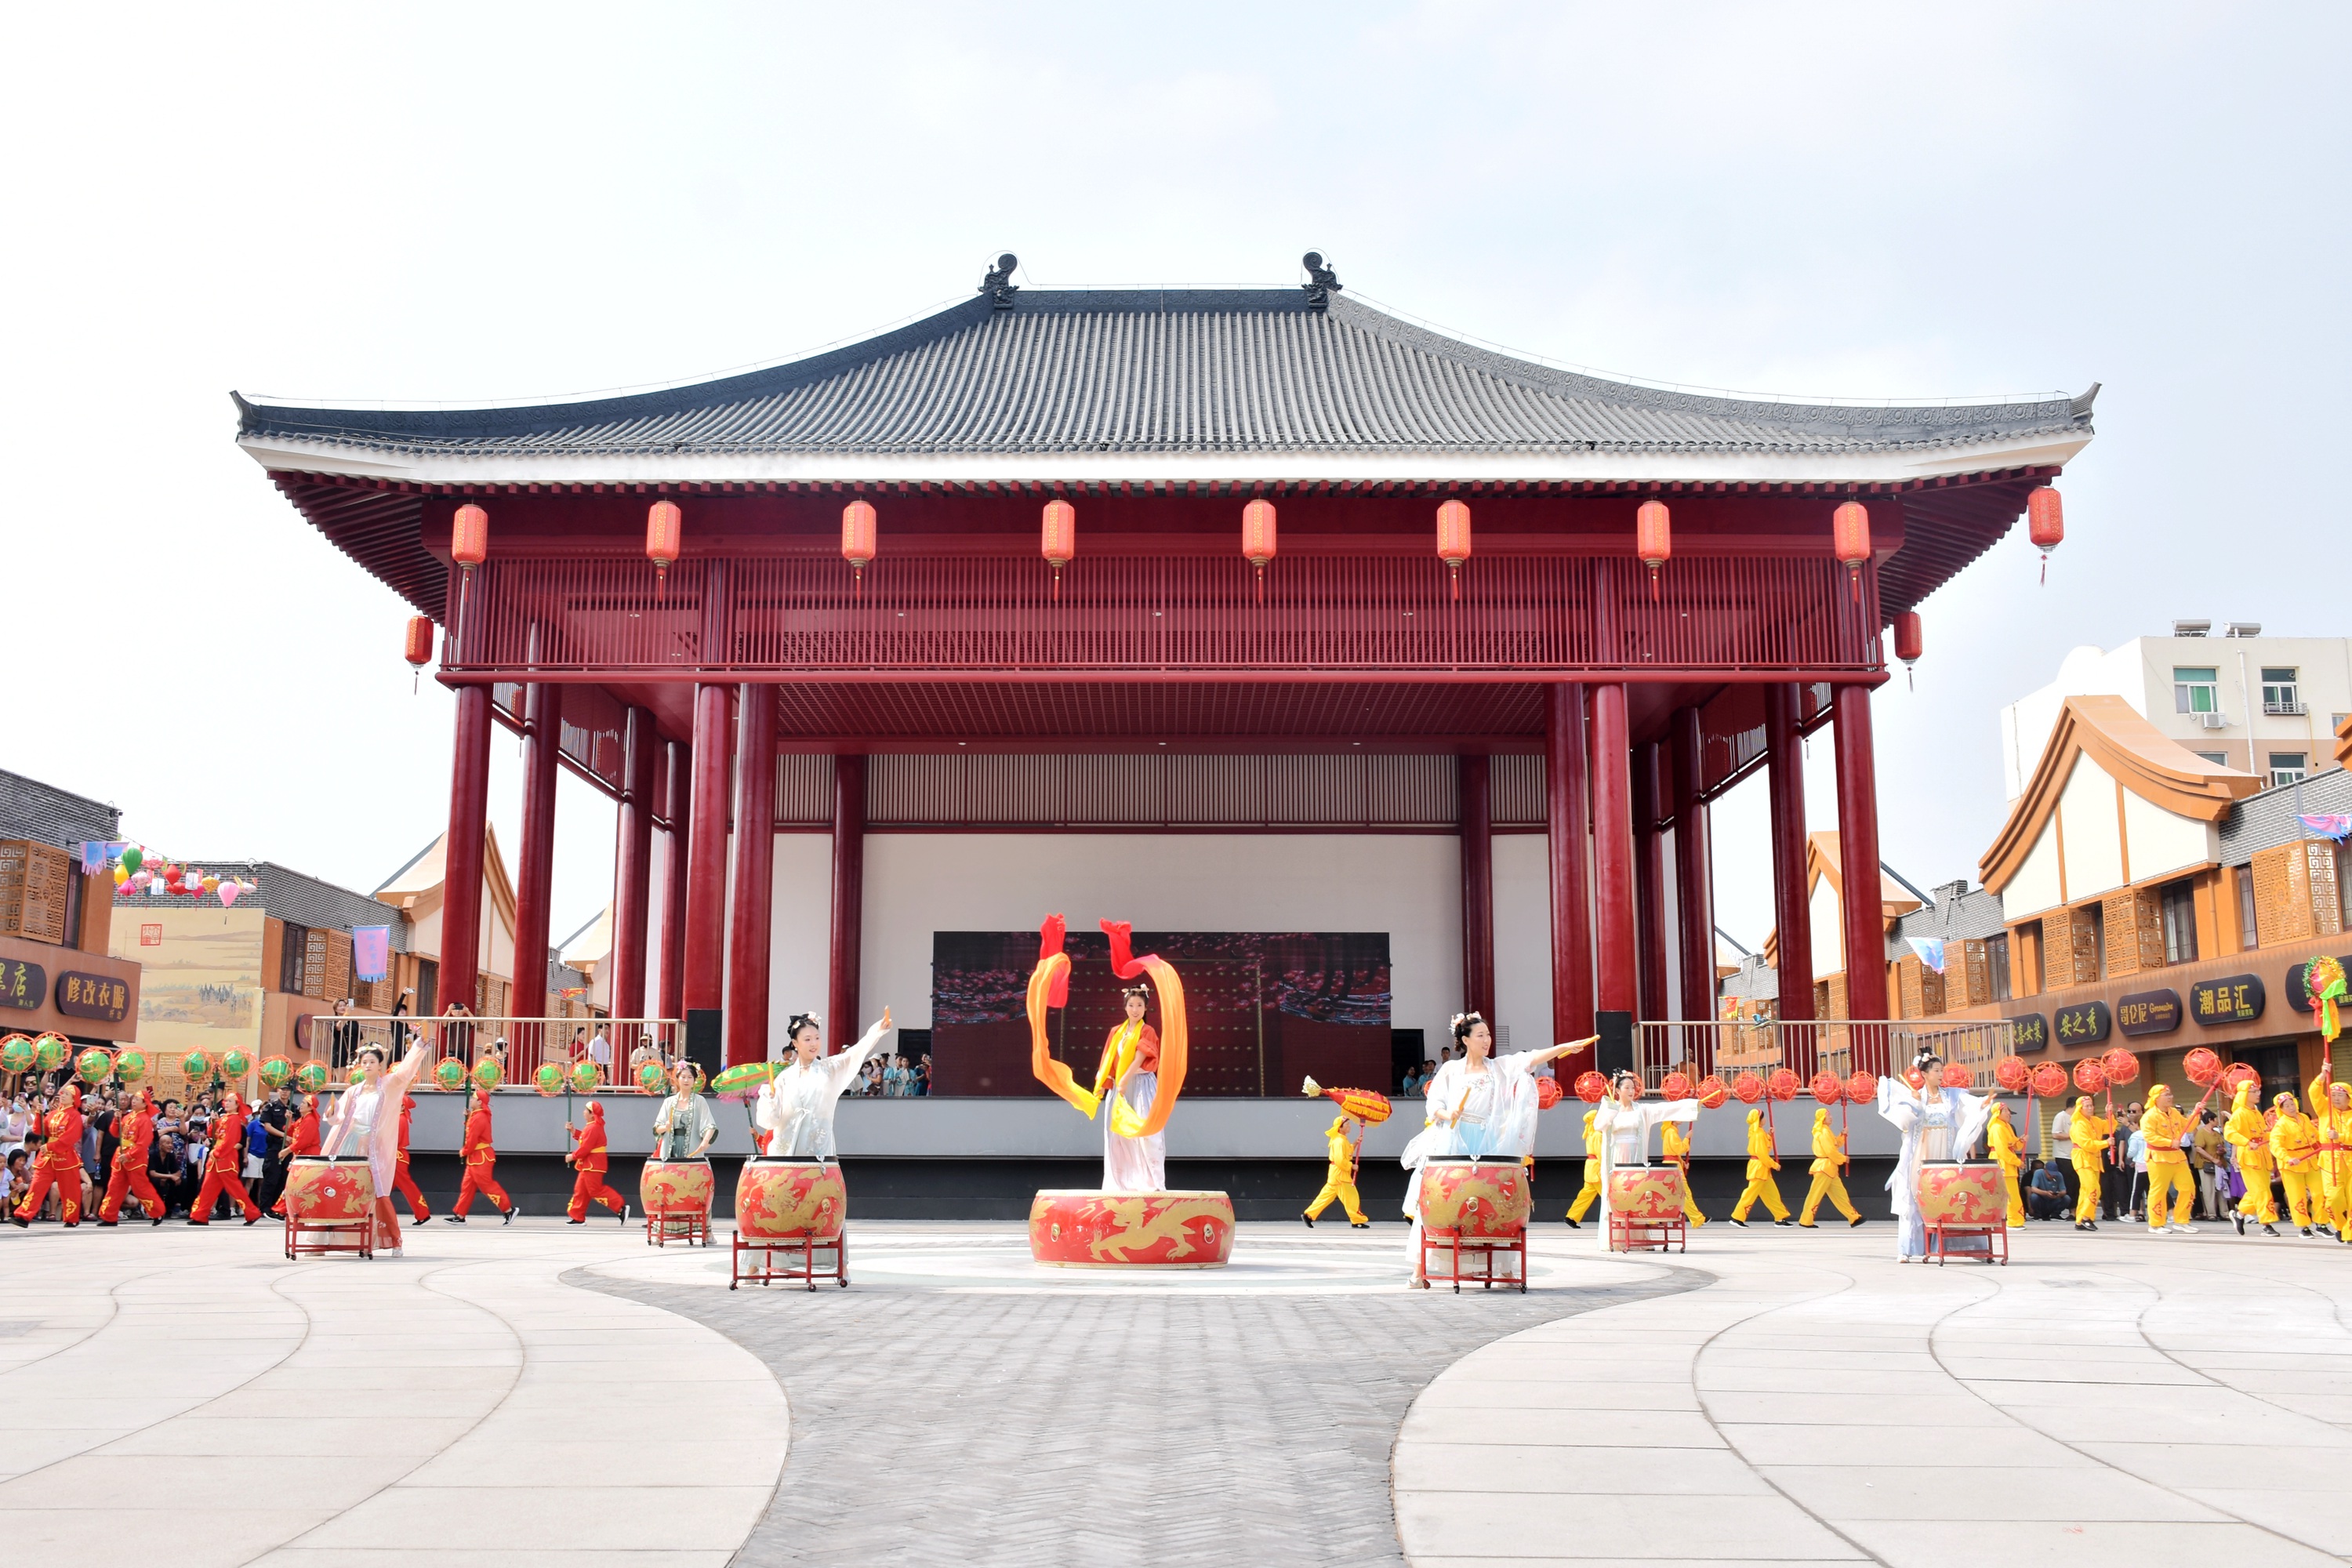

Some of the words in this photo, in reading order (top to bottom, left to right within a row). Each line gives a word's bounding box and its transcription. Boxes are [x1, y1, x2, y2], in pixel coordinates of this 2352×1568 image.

[67, 976, 125, 1009] 修改衣服
[2199, 985, 2250, 1014] 潮品汇
[2120, 1003, 2147, 1025] 哥仑尼
